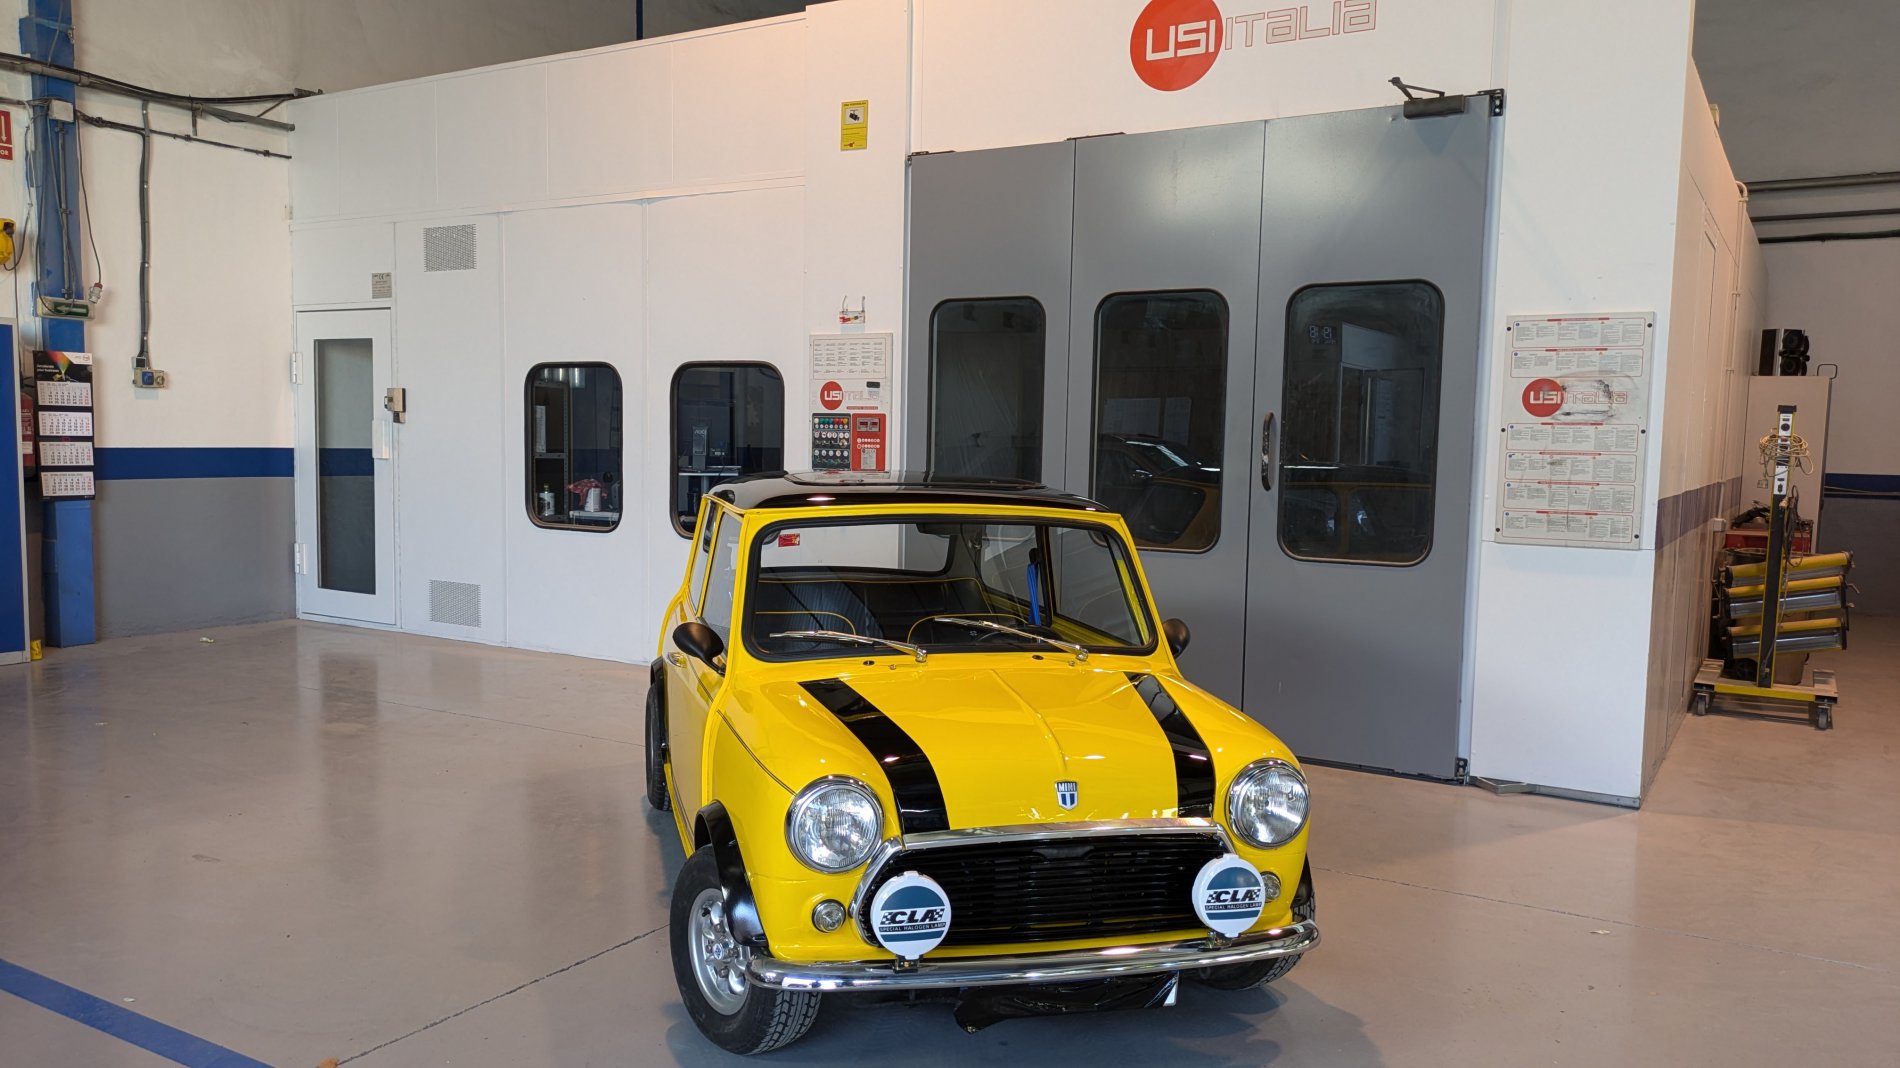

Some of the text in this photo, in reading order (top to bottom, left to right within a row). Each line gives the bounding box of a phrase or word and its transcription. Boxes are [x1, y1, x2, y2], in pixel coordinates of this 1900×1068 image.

[1146, 20, 1217, 61] USI
[824, 390, 843, 401] USI
[1529, 390, 1561, 404] USI
[1058, 782, 1076, 792] MINI
[1214, 889, 1255, 903] CLA
[889, 909, 936, 925] CLA
